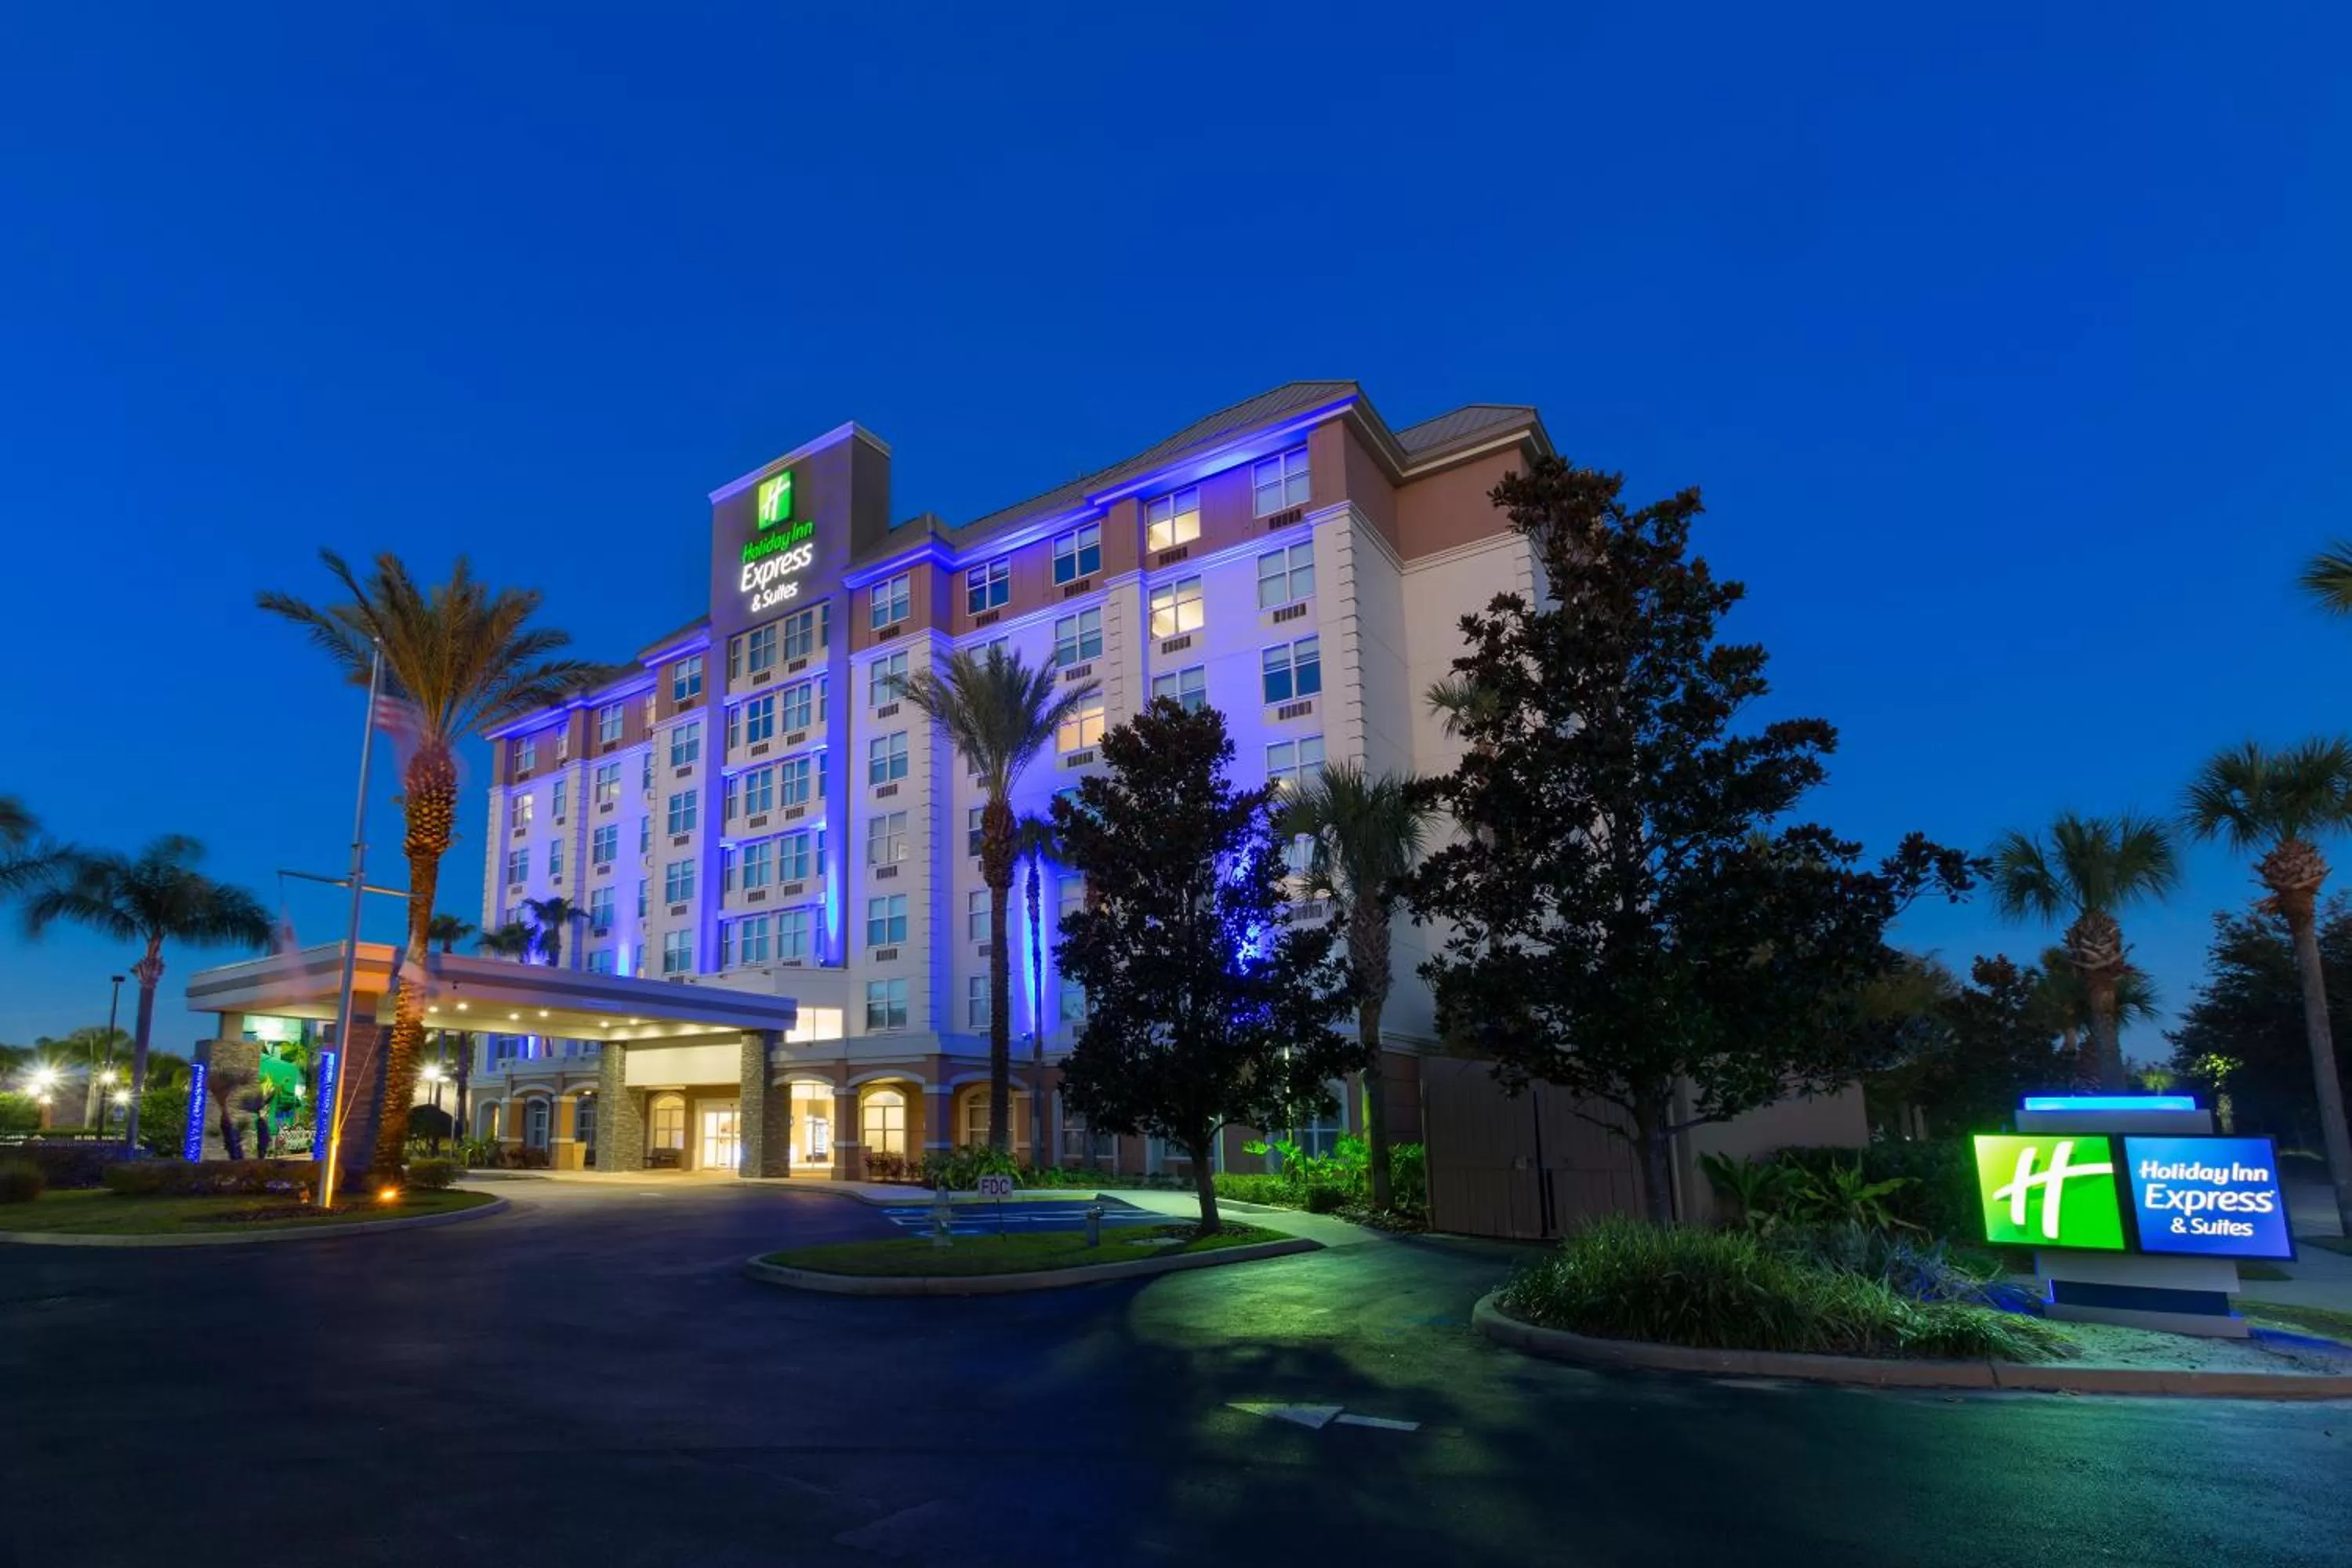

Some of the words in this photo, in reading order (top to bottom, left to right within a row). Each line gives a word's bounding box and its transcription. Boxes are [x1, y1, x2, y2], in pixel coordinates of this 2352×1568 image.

[742, 532, 791, 564] Holiday
[791, 521, 814, 540] Inn
[741, 543, 813, 592] Express
[751, 593, 761, 612] &
[762, 582, 799, 608] Suites
[981, 1178, 1009, 1195] FDC
[2140, 1160, 2228, 1185] Holiday
[2232, 1162, 2269, 1182] Inn
[2144, 1184, 2274, 1216] Express
[2170, 1218, 2187, 1234] &
[2190, 1218, 2254, 1236] Suites
